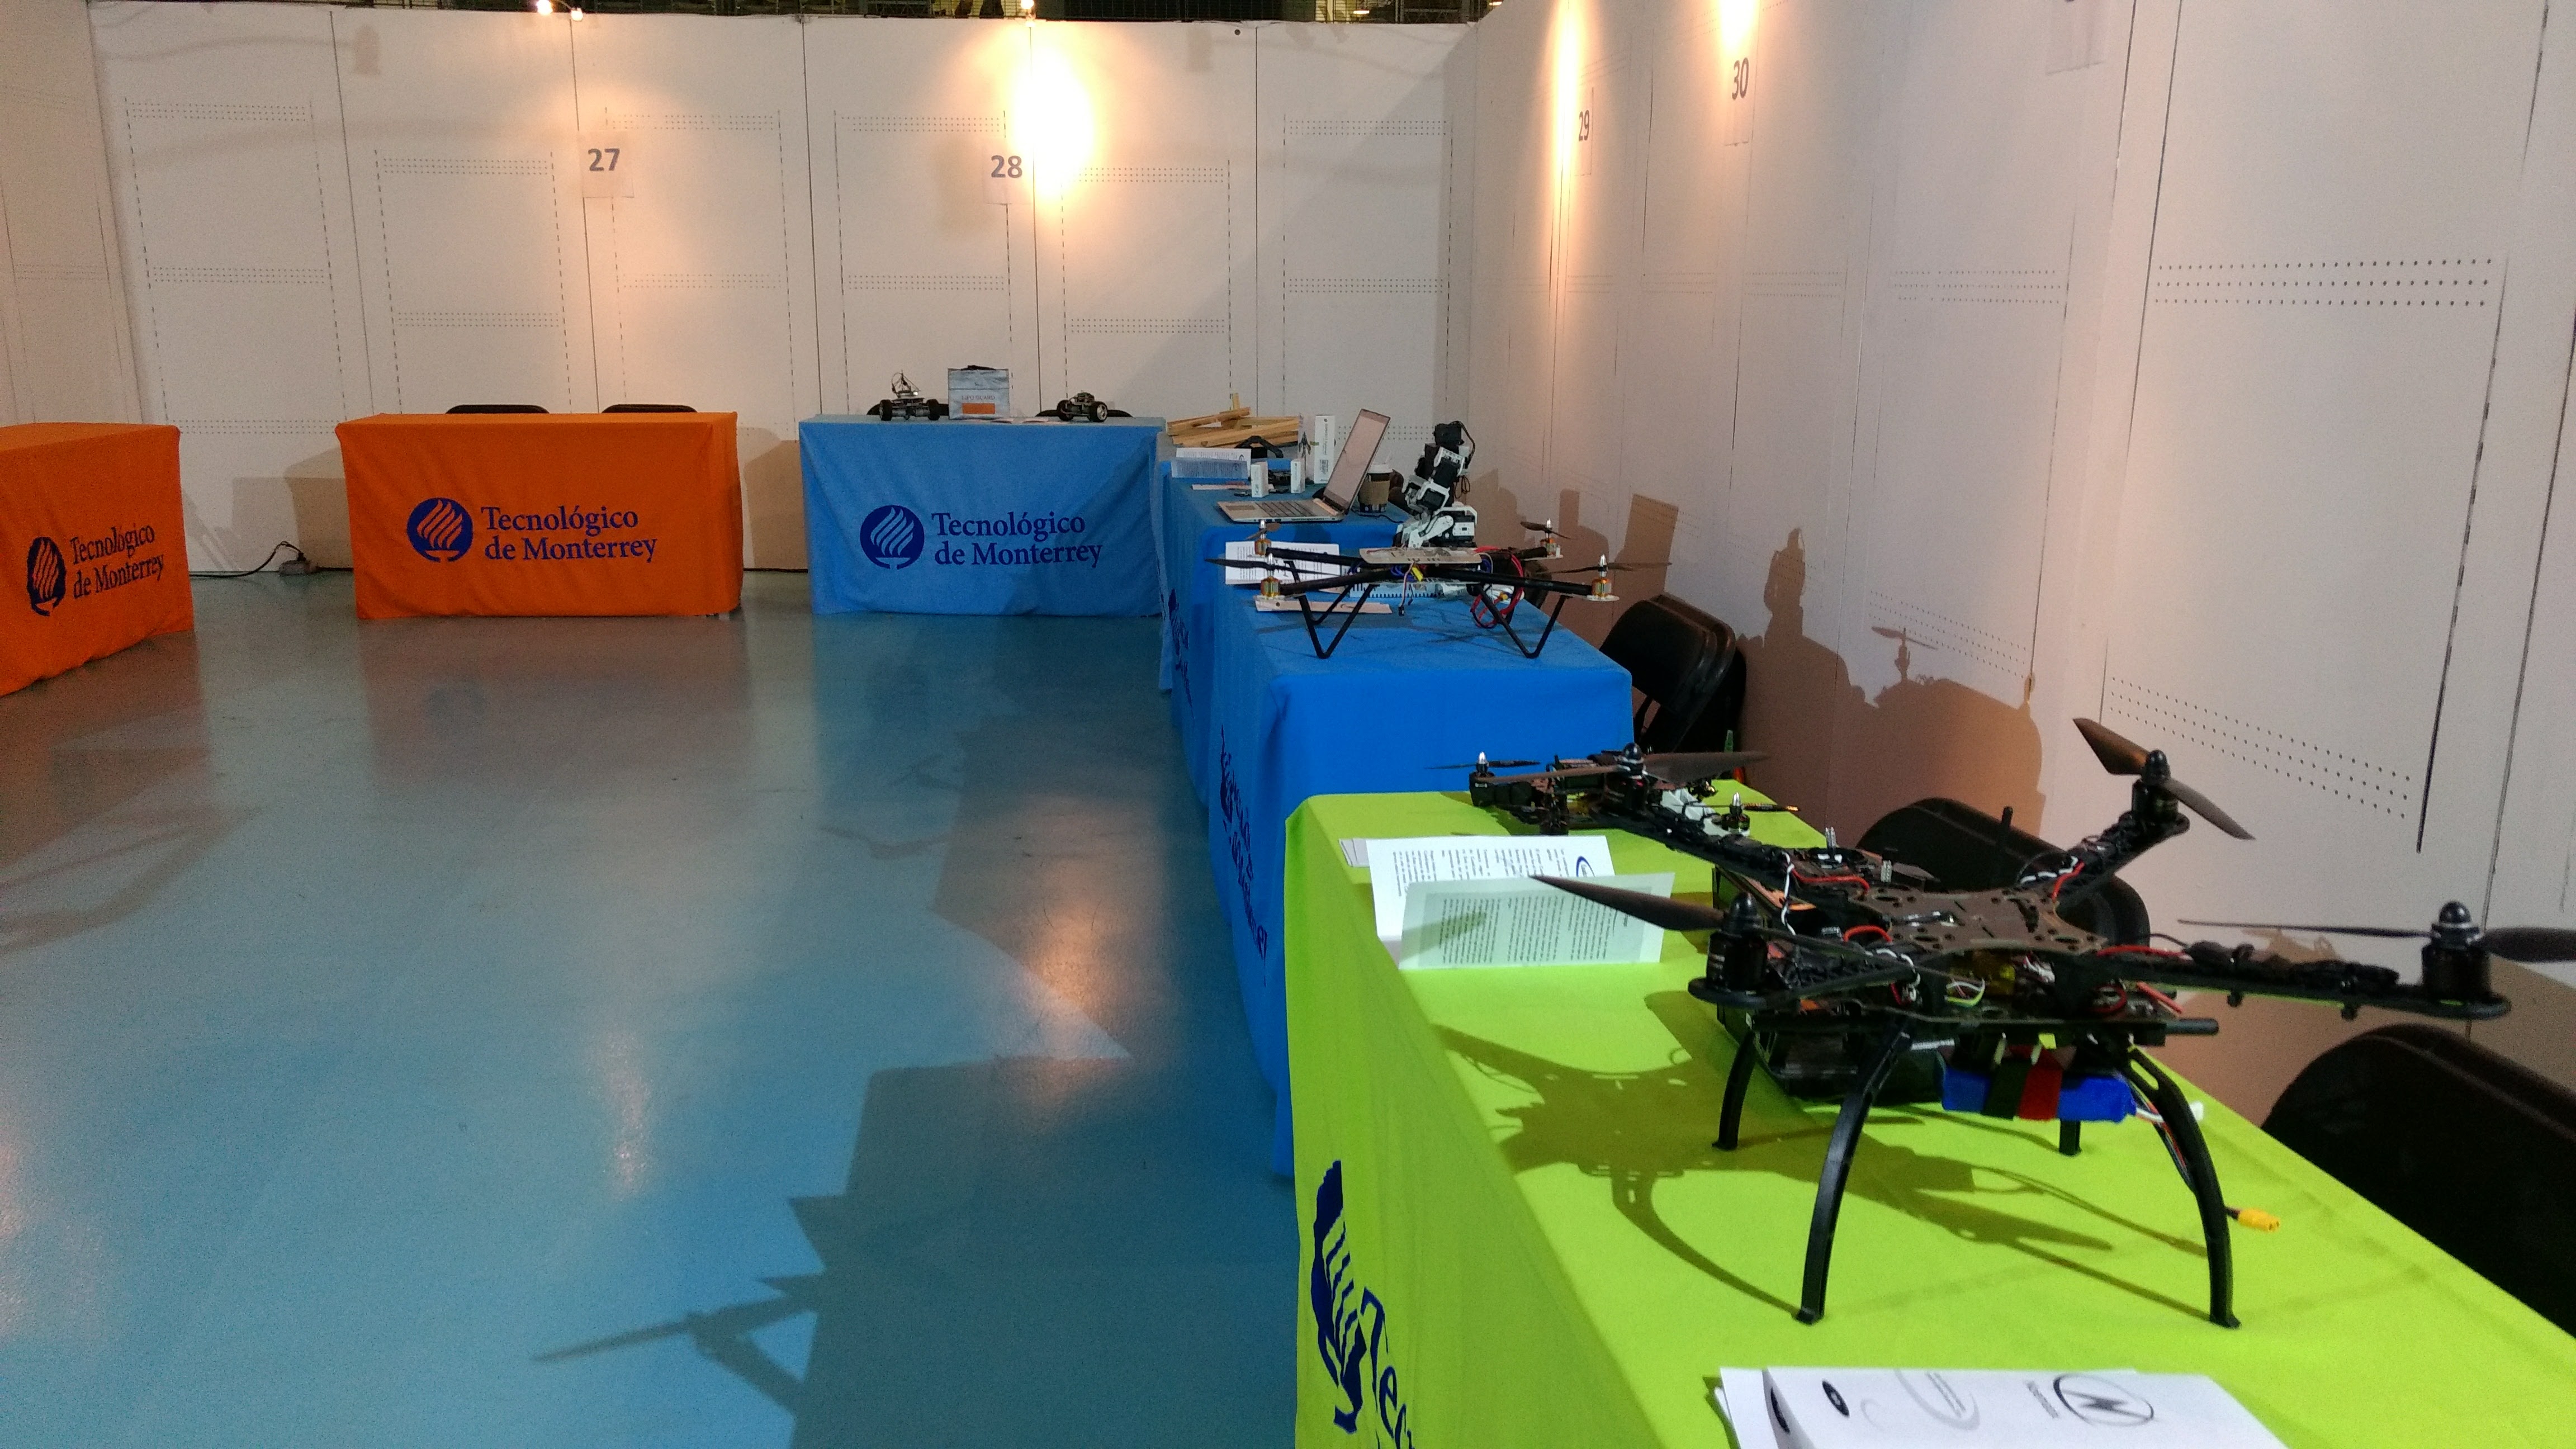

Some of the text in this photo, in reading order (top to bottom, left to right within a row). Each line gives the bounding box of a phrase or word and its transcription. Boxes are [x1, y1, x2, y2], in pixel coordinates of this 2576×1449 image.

[1732, 57, 1749, 101] 30
[1578, 110, 1590, 141] 29
[588, 148, 620, 172] 27
[991, 155, 1022, 178] 28
[481, 505, 638, 537] Tecnológico
[931, 511, 1086, 542] Tecnológico
[70, 523, 155, 565] Tecnológico
[484, 534, 658, 564] de Monterrey
[934, 540, 1103, 569] de Monterrey
[73, 554, 164, 599] de Monterrey
